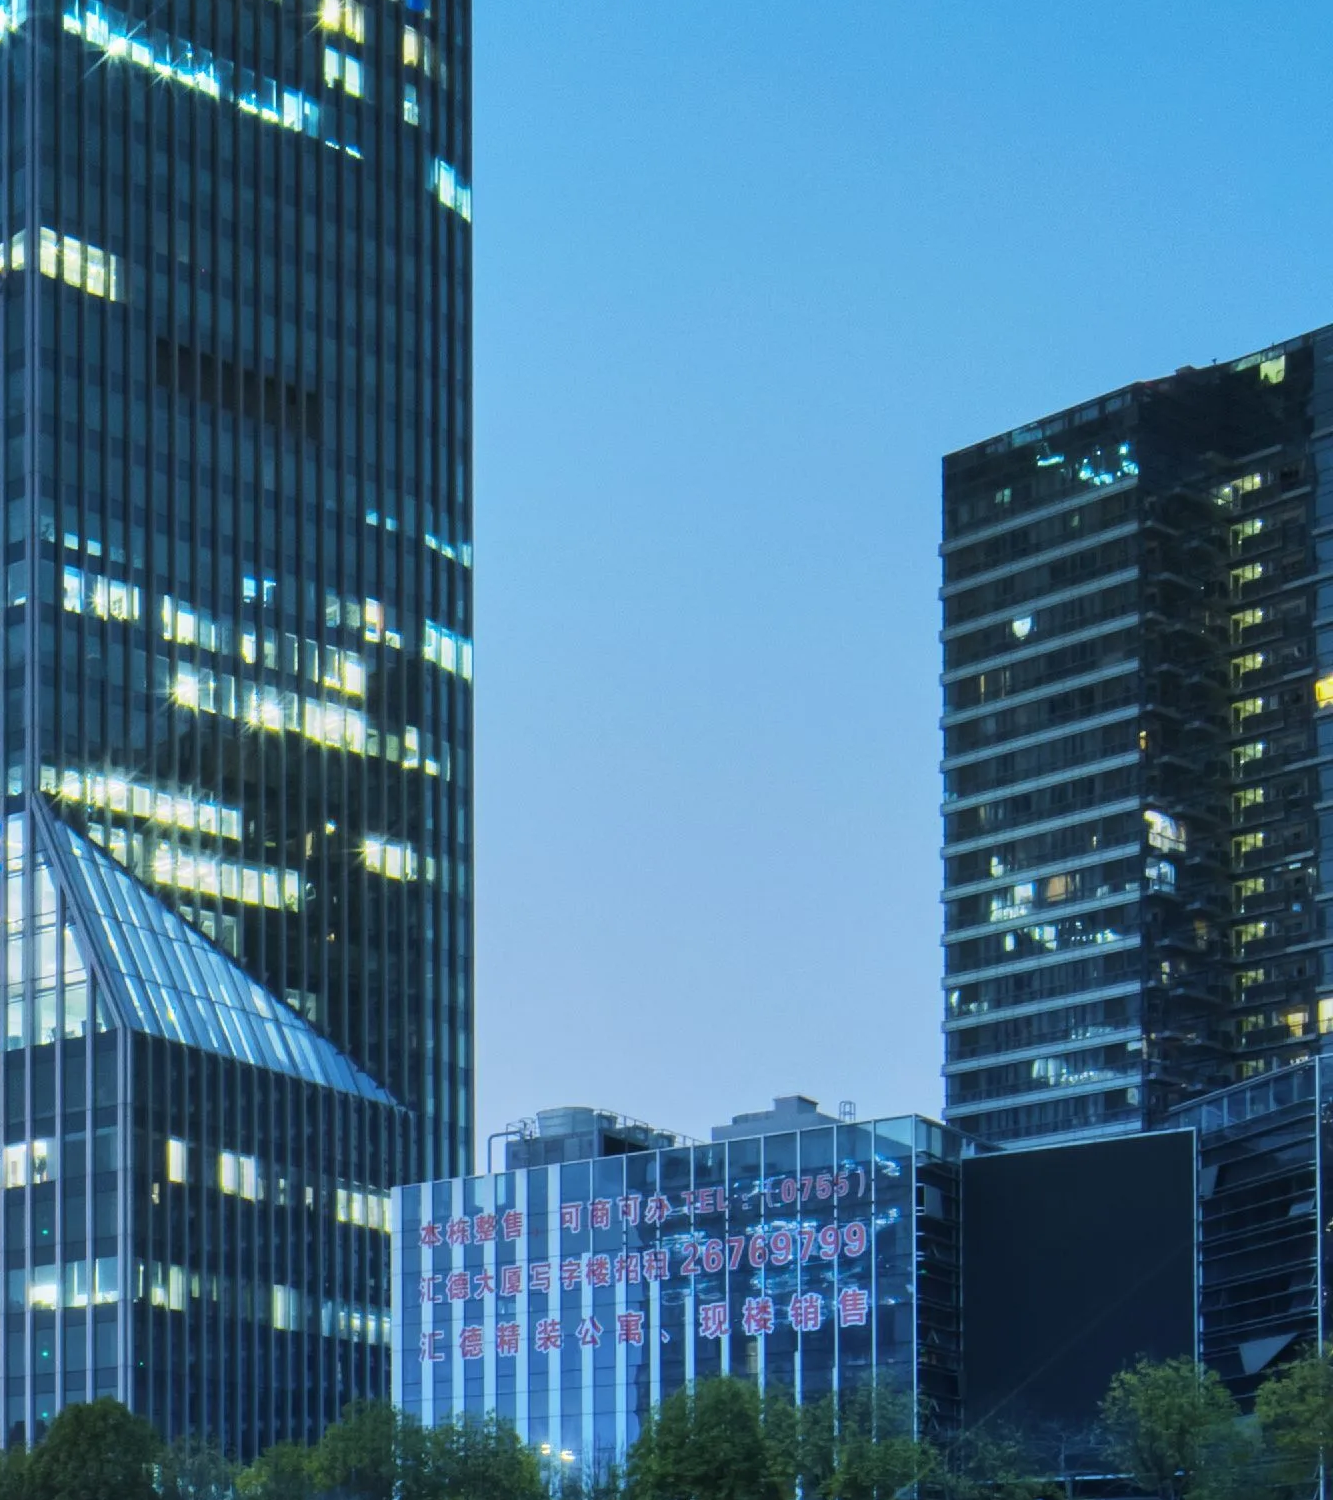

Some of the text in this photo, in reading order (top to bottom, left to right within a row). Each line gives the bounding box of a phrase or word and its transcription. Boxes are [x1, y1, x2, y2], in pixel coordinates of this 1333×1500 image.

[419, 1221, 867, 1304] 汇德大厦写字楼招租 26769799
